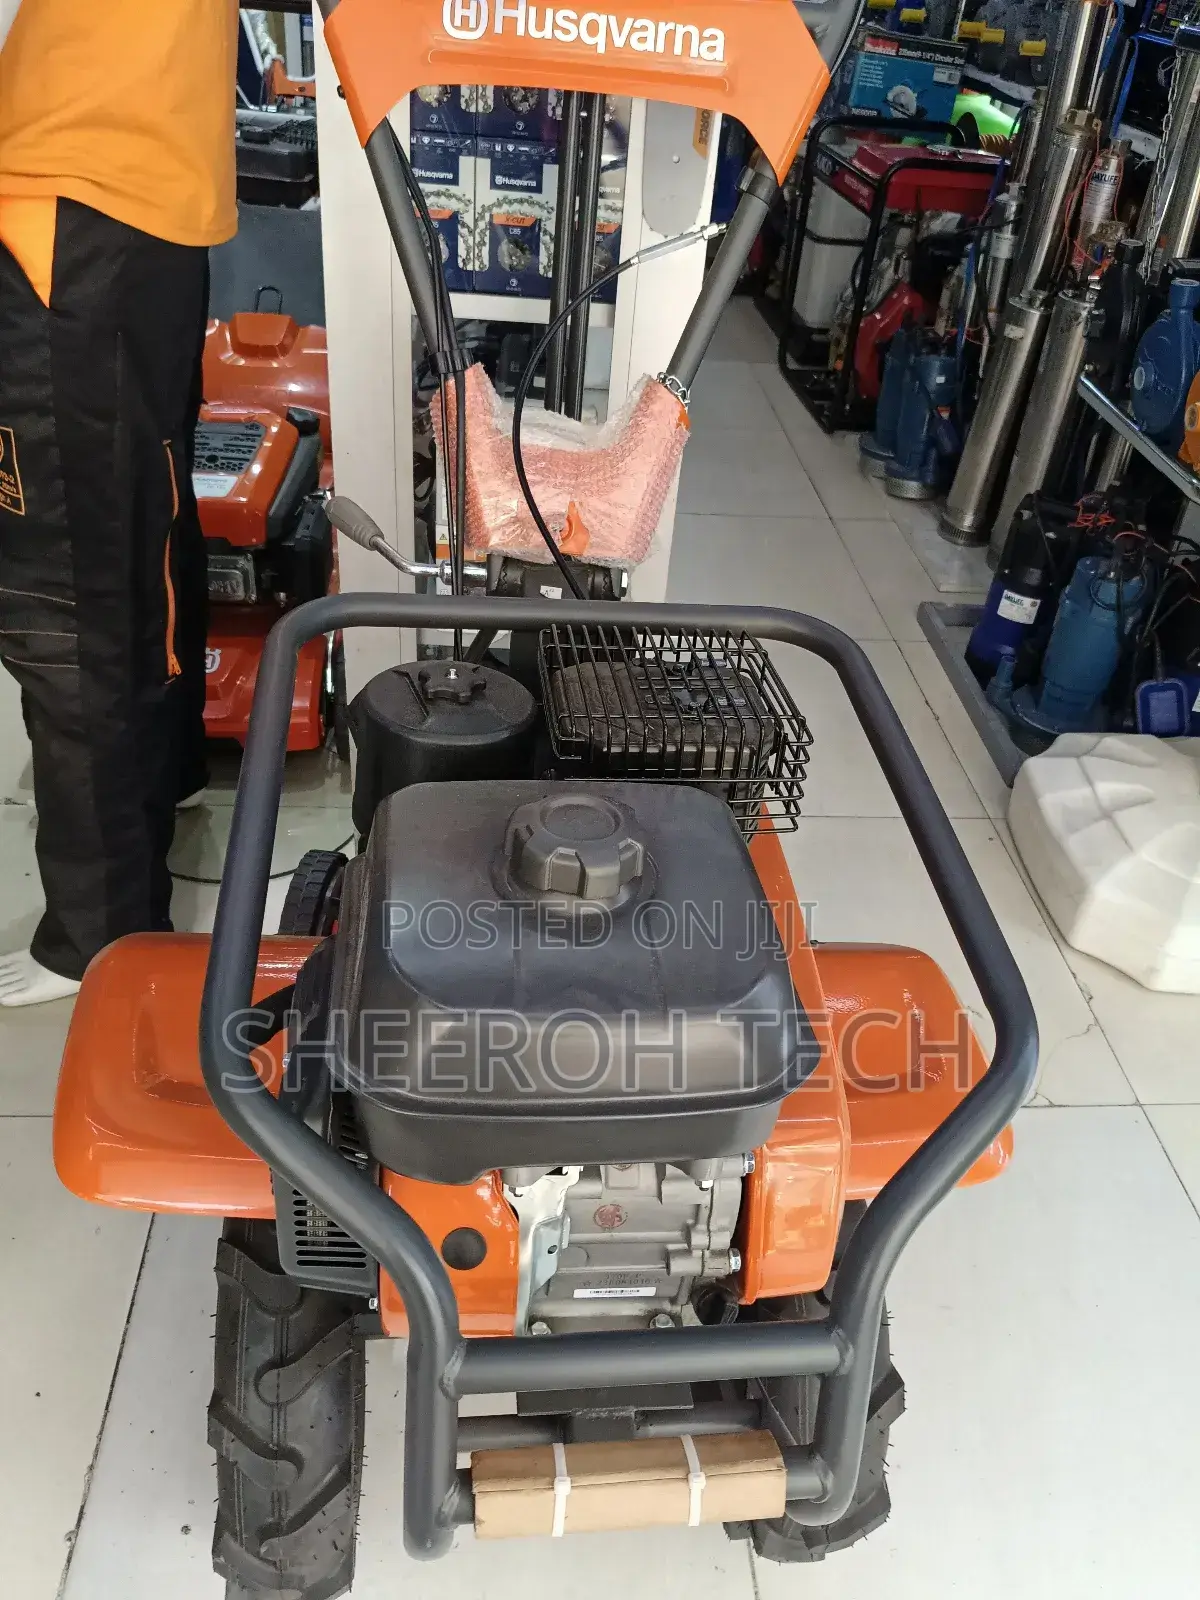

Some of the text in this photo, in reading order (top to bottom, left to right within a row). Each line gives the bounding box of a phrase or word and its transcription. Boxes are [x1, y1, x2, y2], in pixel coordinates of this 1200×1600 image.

[493, 0, 726, 62] Husqvarna
[418, 169, 453, 180] Husqvarna
[502, 177, 537, 187] Husqvarna
[598, 186, 621, 194] qvarna
